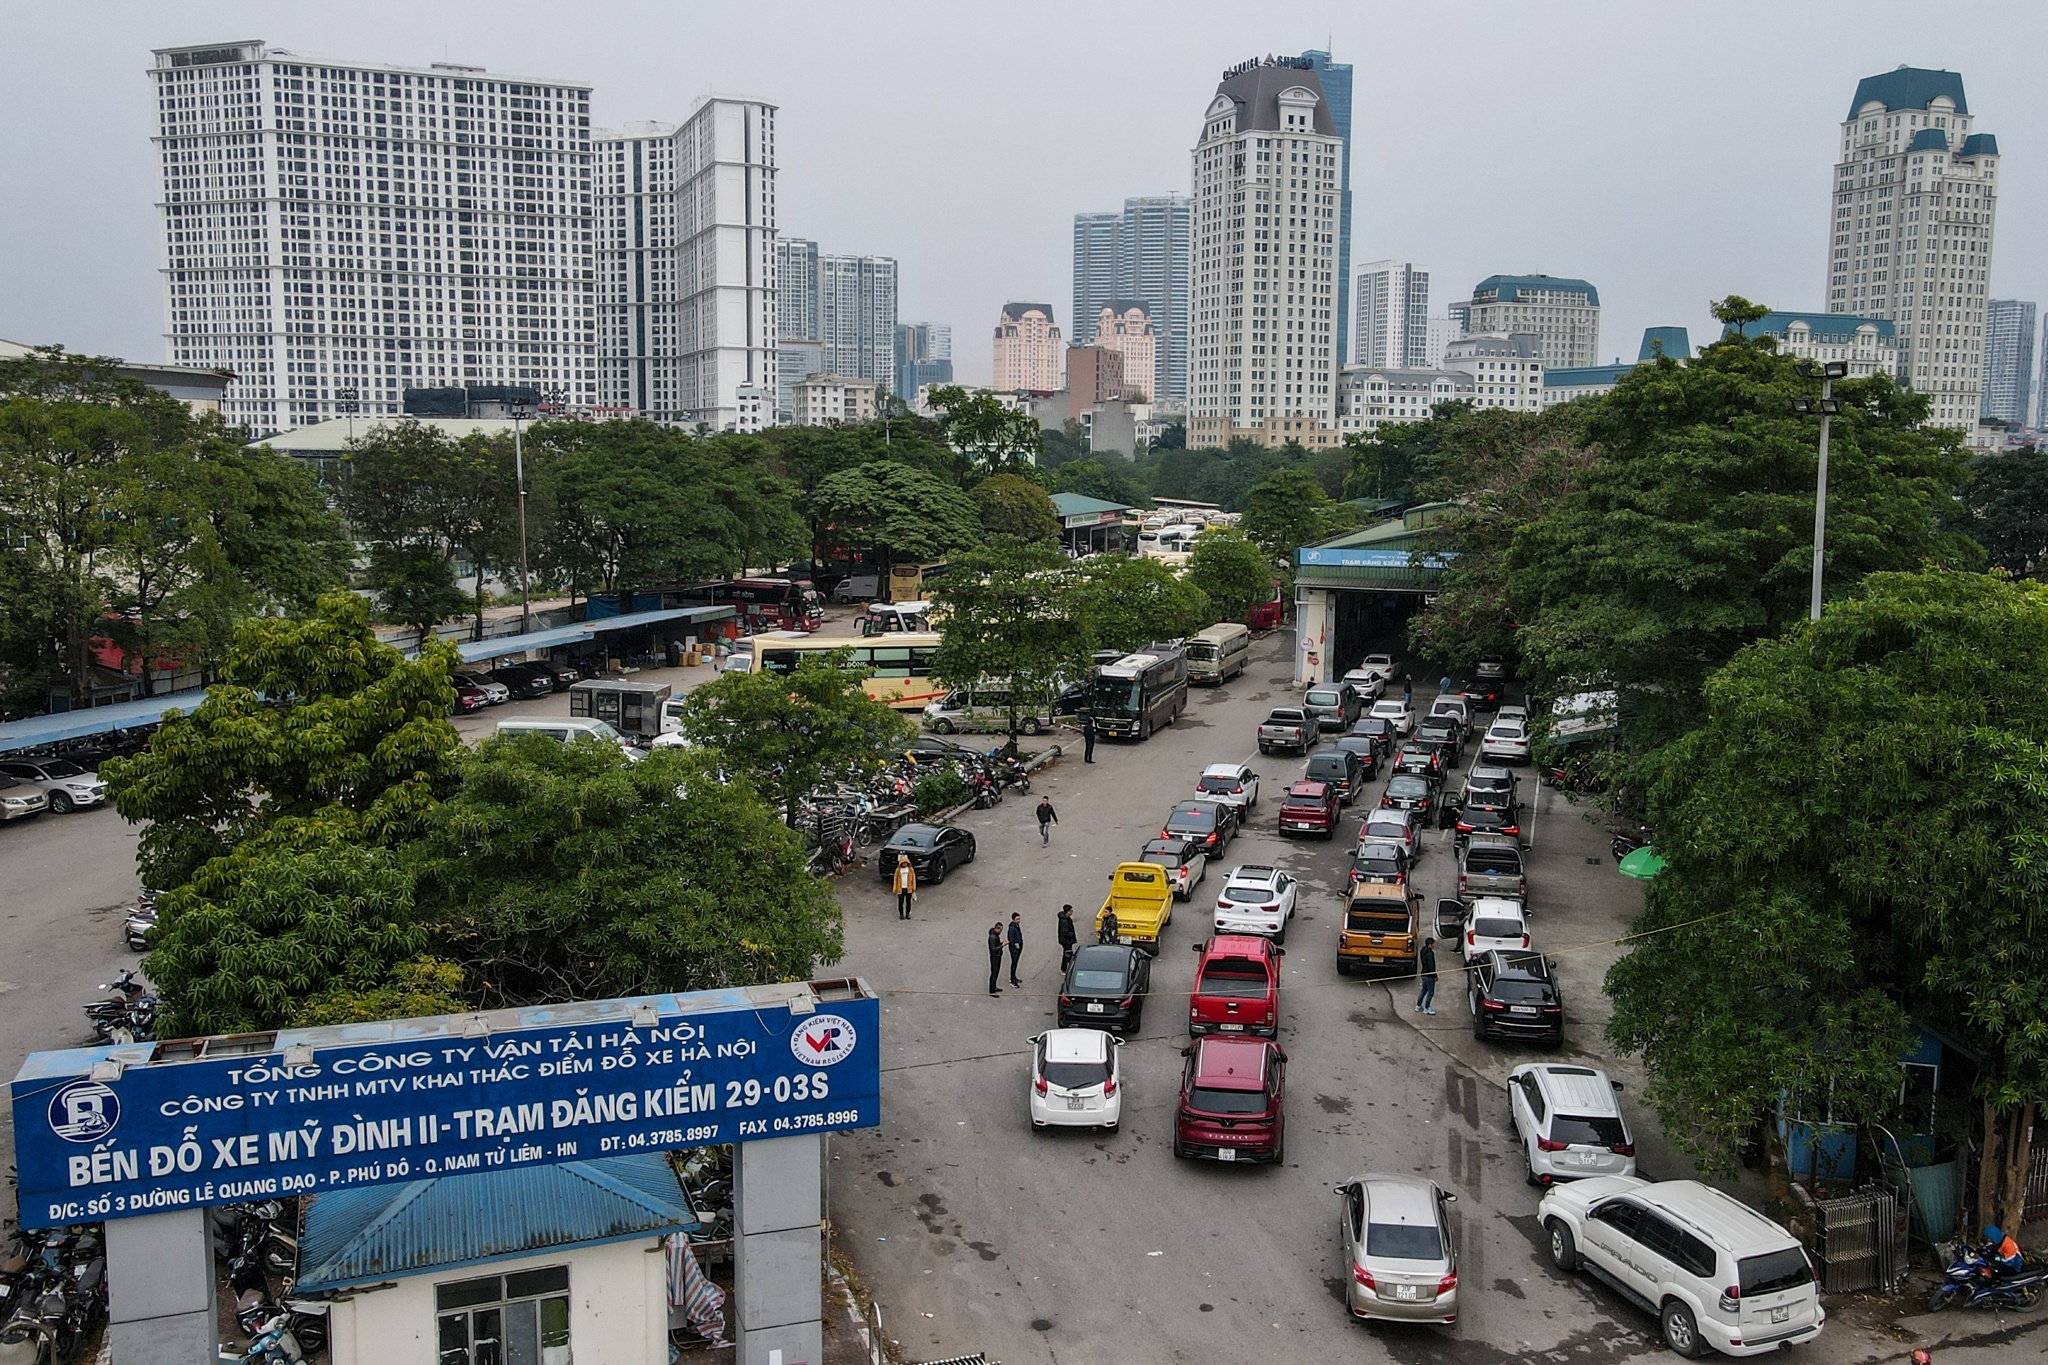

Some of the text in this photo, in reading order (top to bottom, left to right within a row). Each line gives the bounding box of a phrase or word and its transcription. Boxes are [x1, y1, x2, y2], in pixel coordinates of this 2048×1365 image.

[160, 1038, 756, 1116] CÔNG TY TNHH MTV KHAI THÁC ĐIỂM ĐỖ XE HÀ NỘI
[227, 1022, 705, 1085] TỔNG CÔNG TY VẬN TẢI HÀ NỘI
[822, 1043, 853, 1065] REGISTER
[68, 1138, 139, 1187] BẾN
[148, 1125, 203, 1177] ĐỖ
[211, 1134, 259, 1169] XE
[268, 1119, 323, 1162] MỸ
[331, 1113, 412, 1155] ĐÌNH
[551, 1087, 638, 1129] ĐĂNG
[644, 1069, 716, 1118] KIỂM
[49, 1203, 85, 1220] Đ/C:
[88, 1192, 111, 1215] SỐ
[115, 1197, 126, 1211] 3
[130, 1187, 190, 1210] ĐƯỜNG
[195, 1181, 214, 1202] LÊ
[219, 1178, 277, 1199] QUANG
[281, 1173, 316, 1193] ĐẠO
[387, 1157, 409, 1178] ĐÔ
[485, 1146, 506, 1166] TỪ
[510, 1143, 542, 1163] LIÊM
[557, 1141, 577, 1157] HN
[739, 1119, 768, 1135] FAX
[773, 1109, 858, 1131] 04.3785.8996
[1600, 1242, 1659, 1284] PRADO
